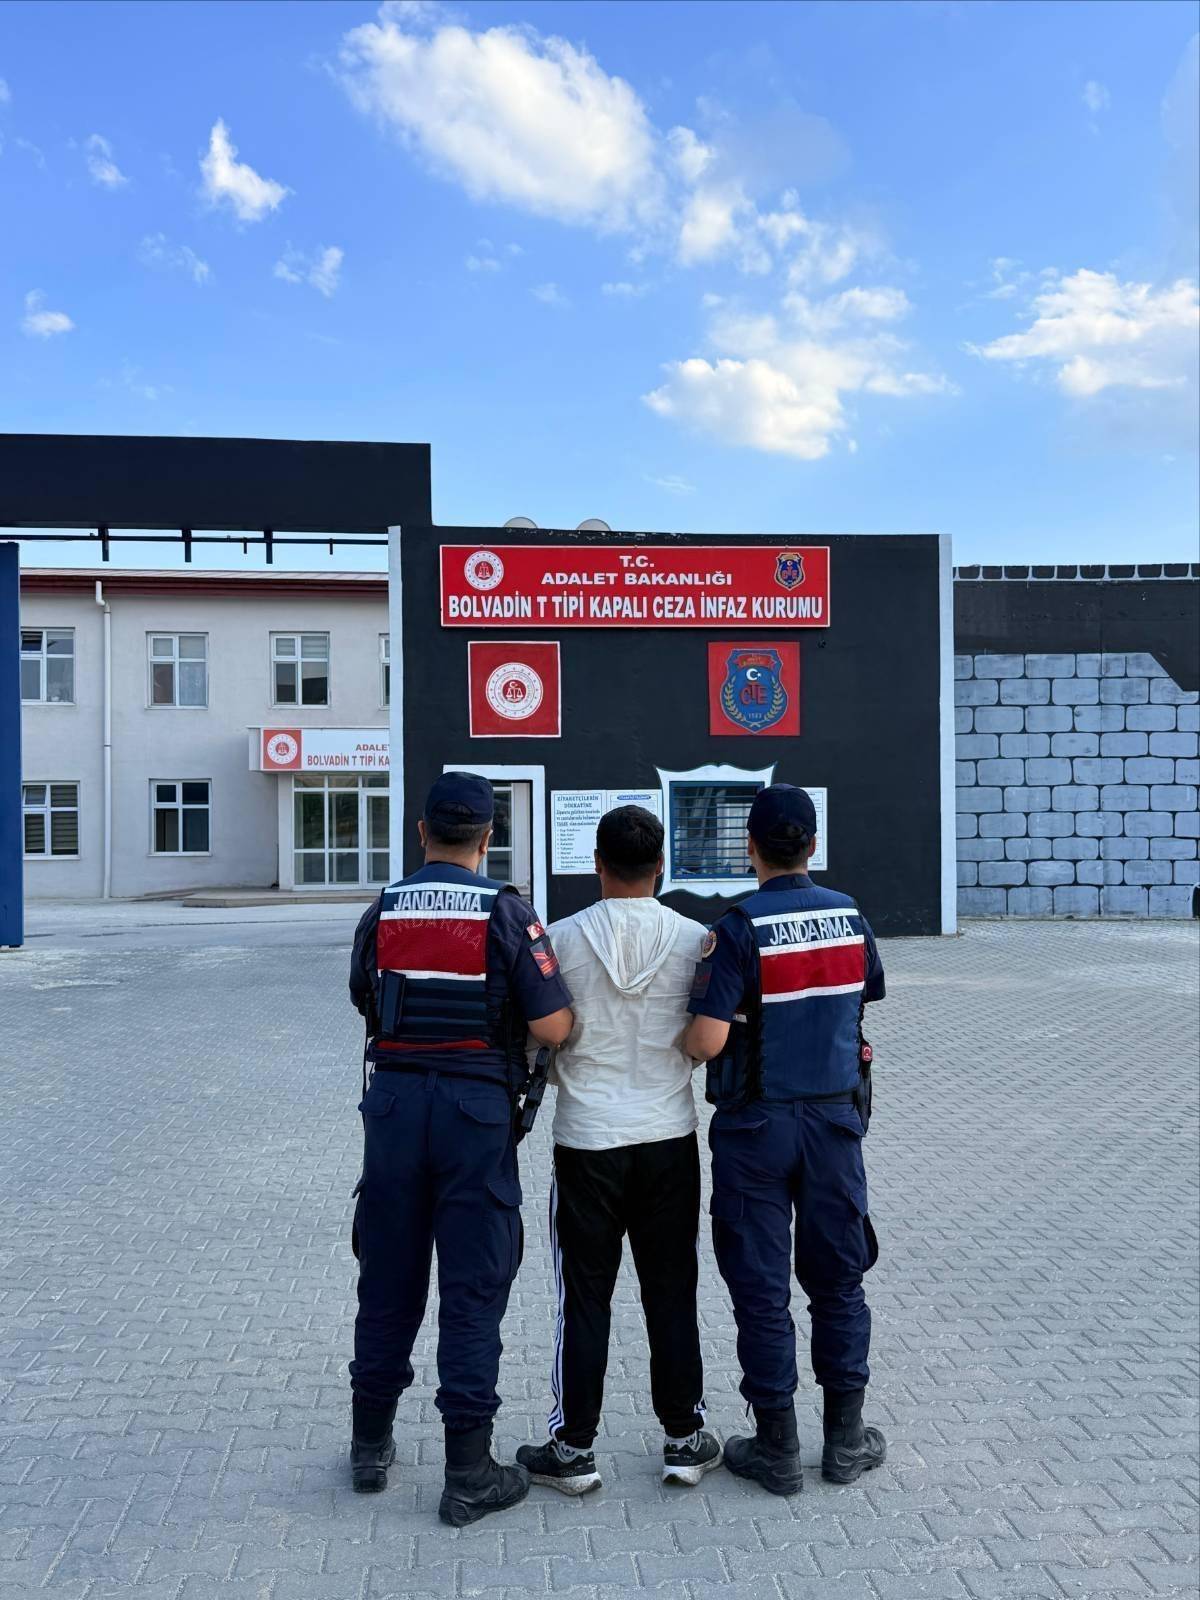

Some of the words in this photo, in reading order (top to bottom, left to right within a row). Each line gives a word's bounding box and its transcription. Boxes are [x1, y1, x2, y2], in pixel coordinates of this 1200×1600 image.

[619, 555, 655, 568] T.C.
[541, 572, 617, 585] ADALET
[624, 570, 732, 586] BAKANLIĞI
[448, 590, 532, 619] BOLVADİN
[537, 595, 548, 618] T
[552, 590, 584, 619] TİPİ
[589, 595, 648, 619] KAPALI
[652, 595, 696, 619] CEZA
[700, 590, 747, 619] İNFAZ
[752, 596, 823, 619] KURUMU
[307, 752, 349, 766] BOLVADİN
[351, 755, 358, 766] T
[359, 752, 376, 766] TİPİ
[393, 890, 482, 912] JANDARMA
[769, 916, 855, 946] JANDARMA
